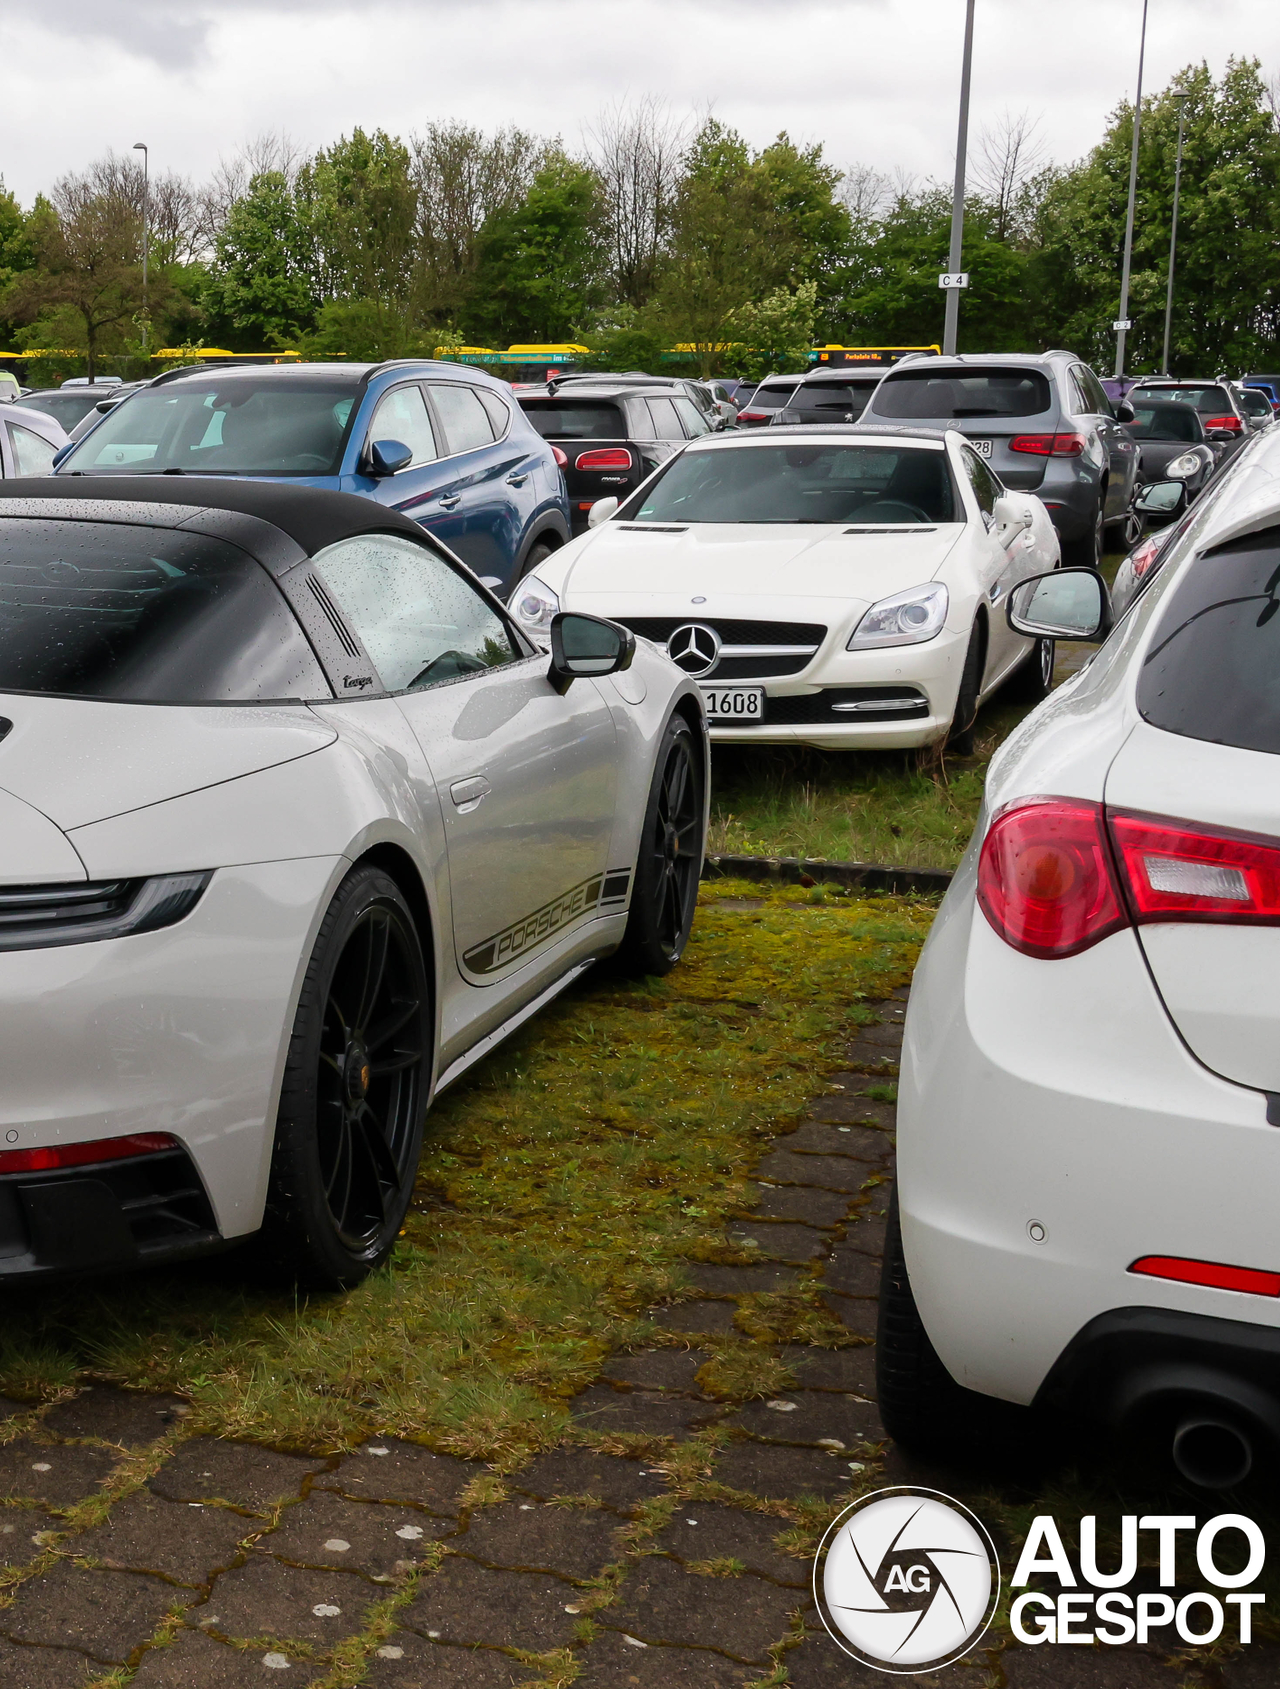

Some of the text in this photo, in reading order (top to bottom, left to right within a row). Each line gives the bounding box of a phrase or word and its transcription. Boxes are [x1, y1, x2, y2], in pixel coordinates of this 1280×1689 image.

[943, 275, 963, 286] C 4
[971, 441, 990, 454] 28
[706, 692, 758, 714] 1608
[497, 888, 585, 961] PORSCHE
